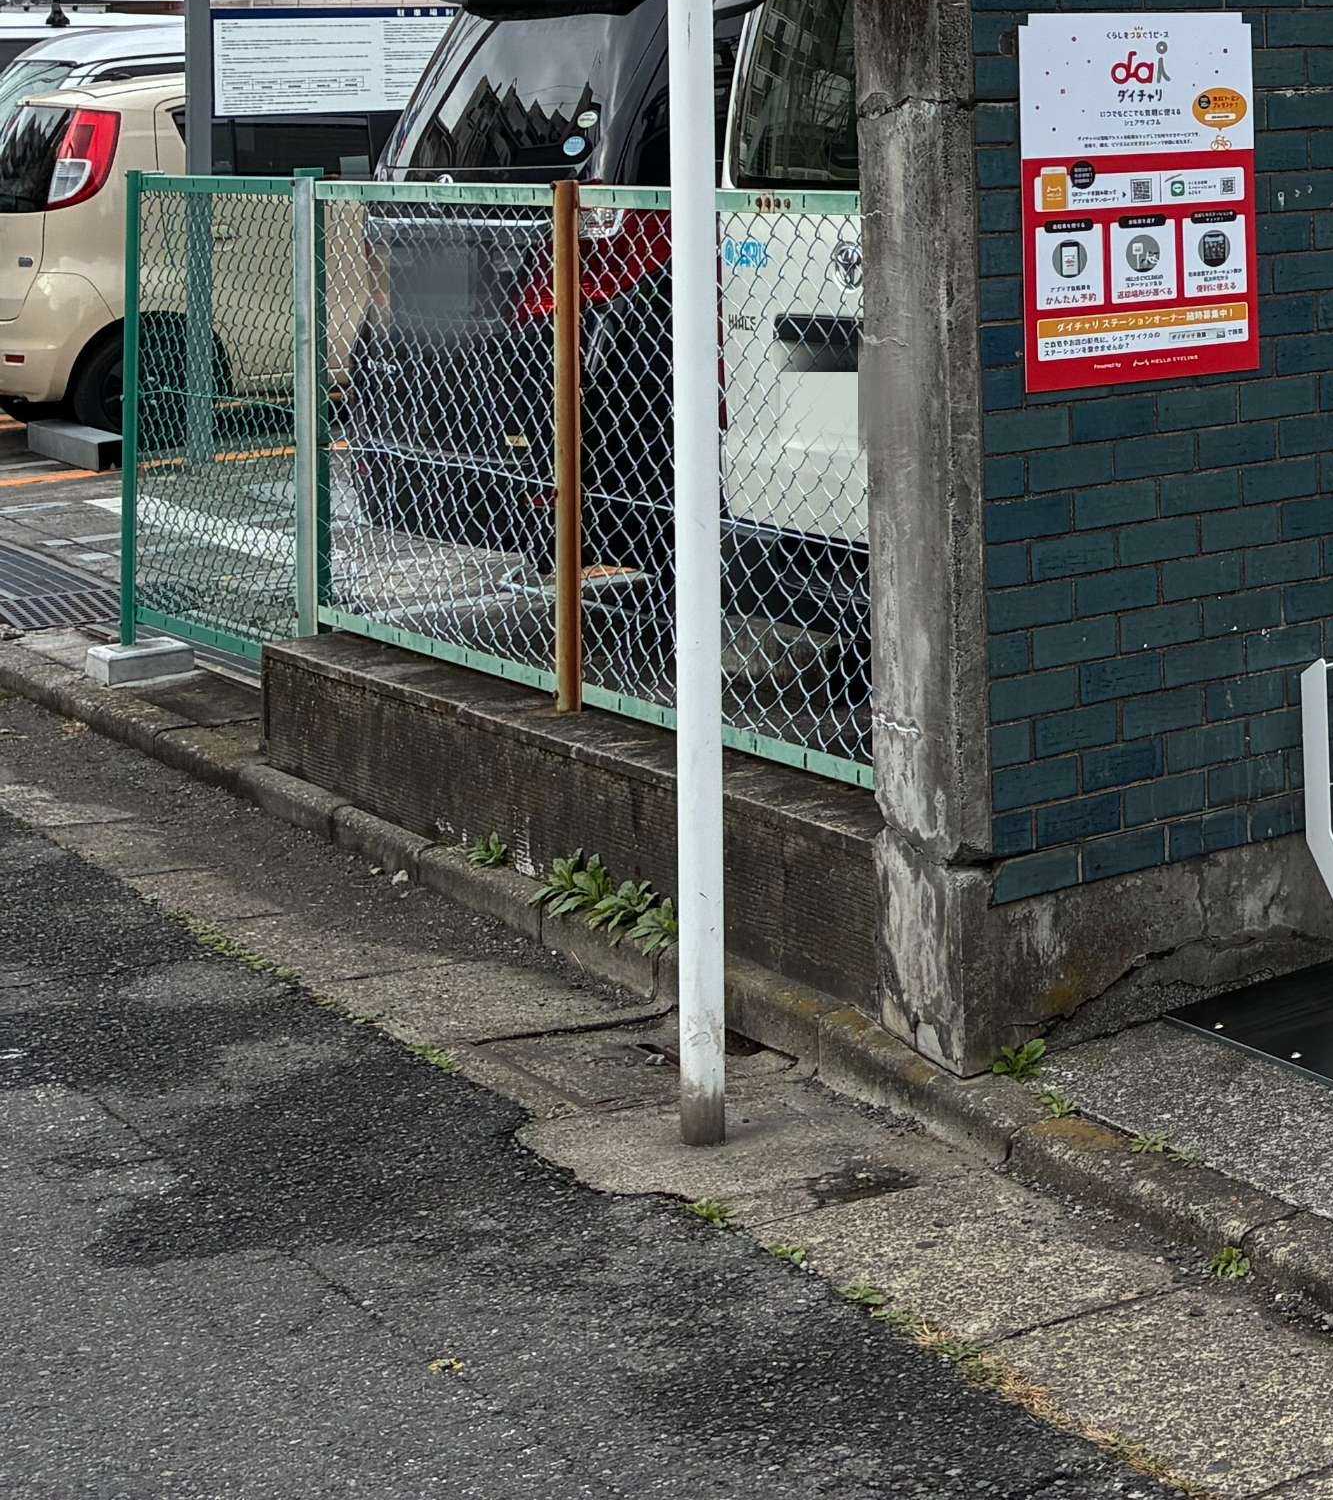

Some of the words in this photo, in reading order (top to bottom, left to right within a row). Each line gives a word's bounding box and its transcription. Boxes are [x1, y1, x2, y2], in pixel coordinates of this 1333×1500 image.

[1110, 41, 1171, 84] dai
[1117, 89, 1162, 102] ダイチャリ
[1057, 321, 1099, 332] ダイチャリ
